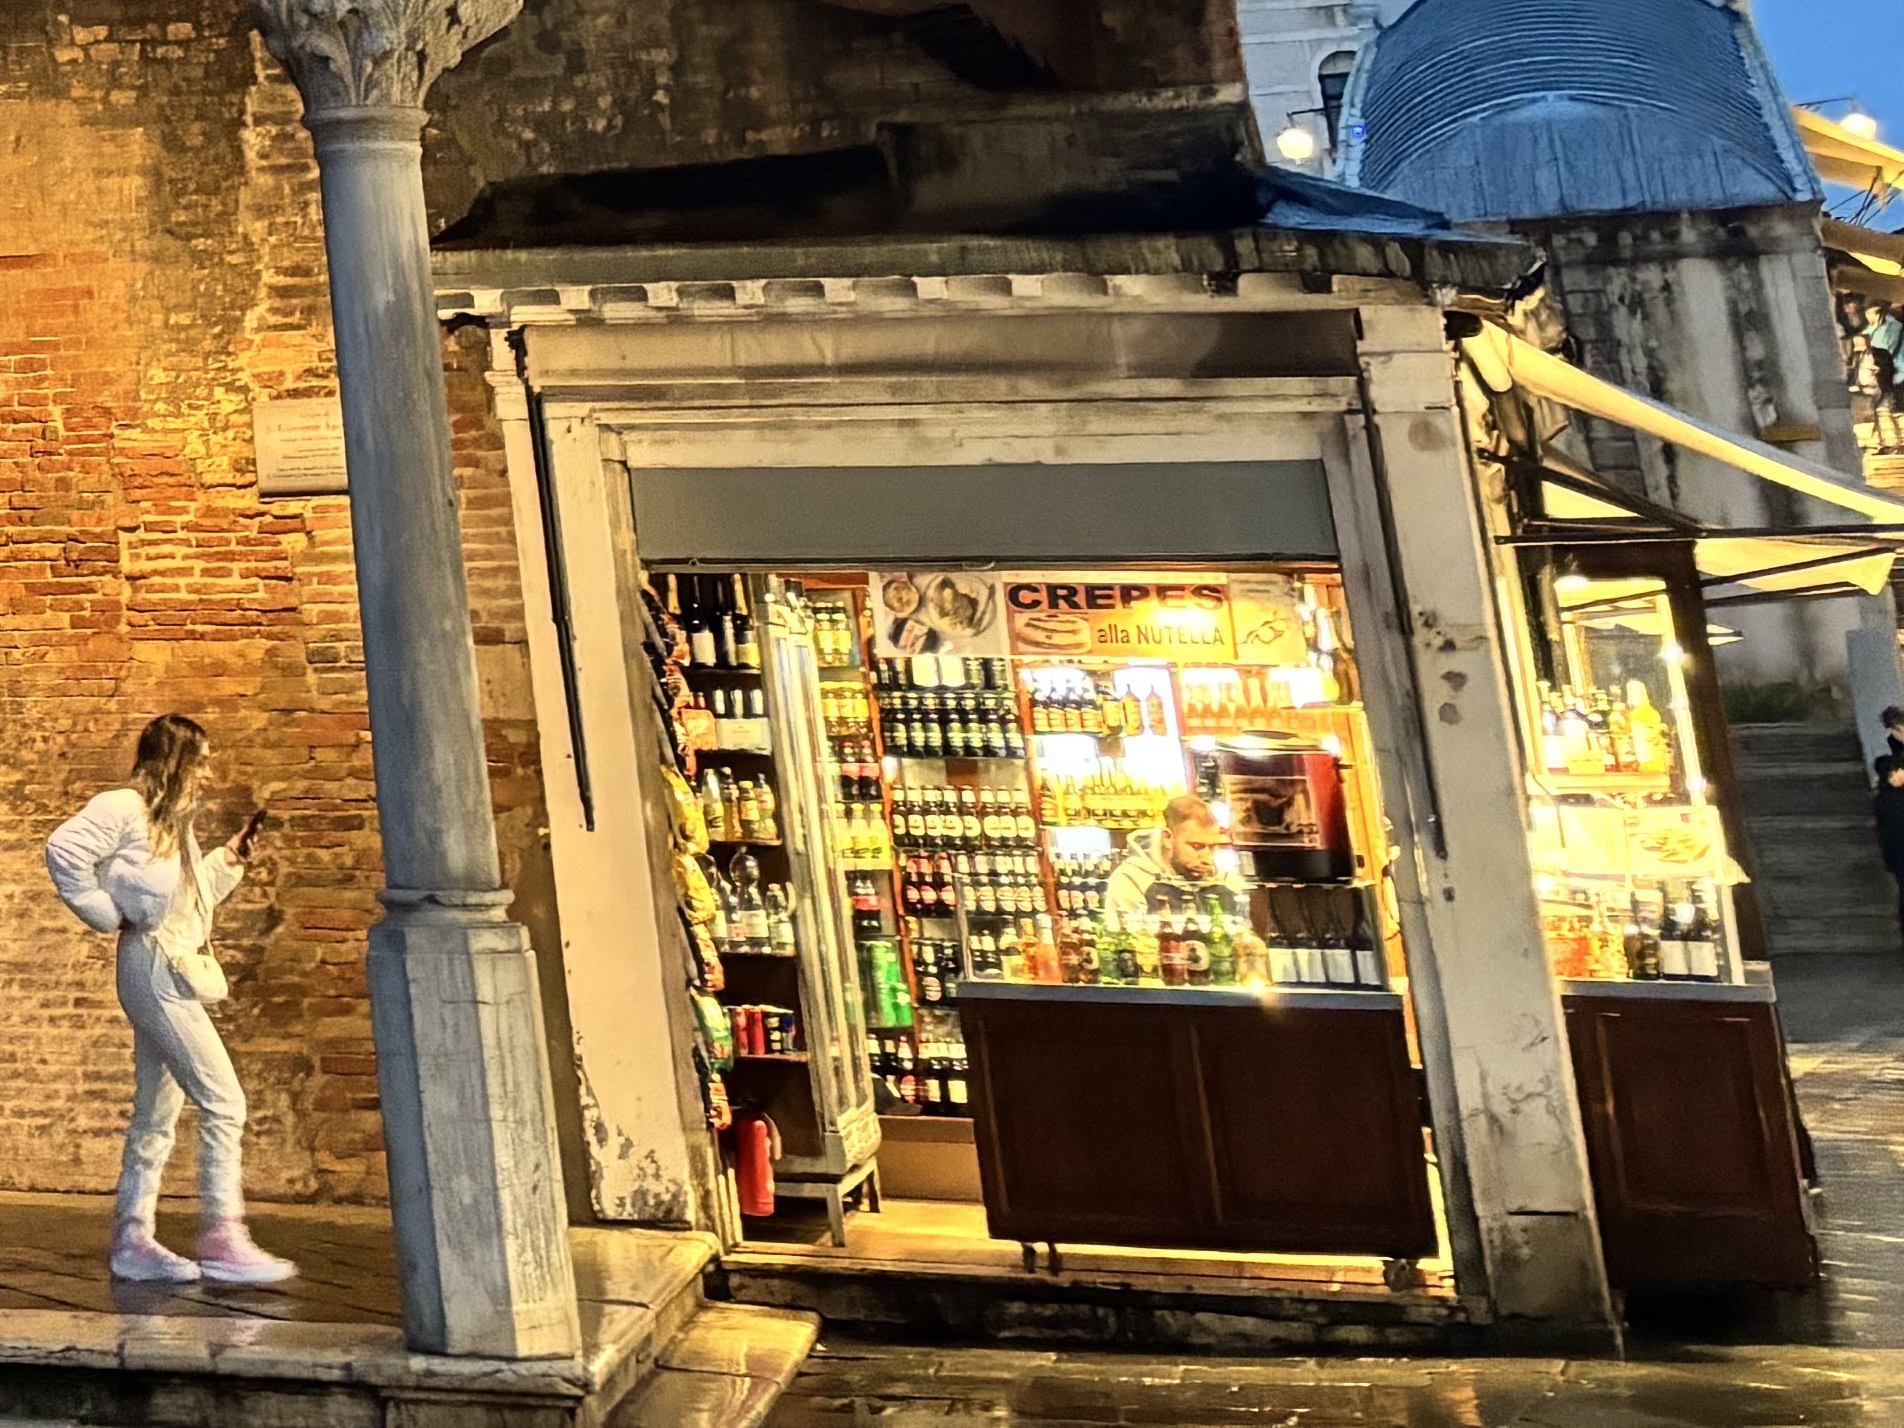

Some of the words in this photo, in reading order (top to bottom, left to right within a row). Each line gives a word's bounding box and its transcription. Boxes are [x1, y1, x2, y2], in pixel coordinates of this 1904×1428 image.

[1007, 583, 1226, 611] CREPES
[1097, 623, 1131, 645] alla
[1136, 622, 1225, 646] NUTELLA
